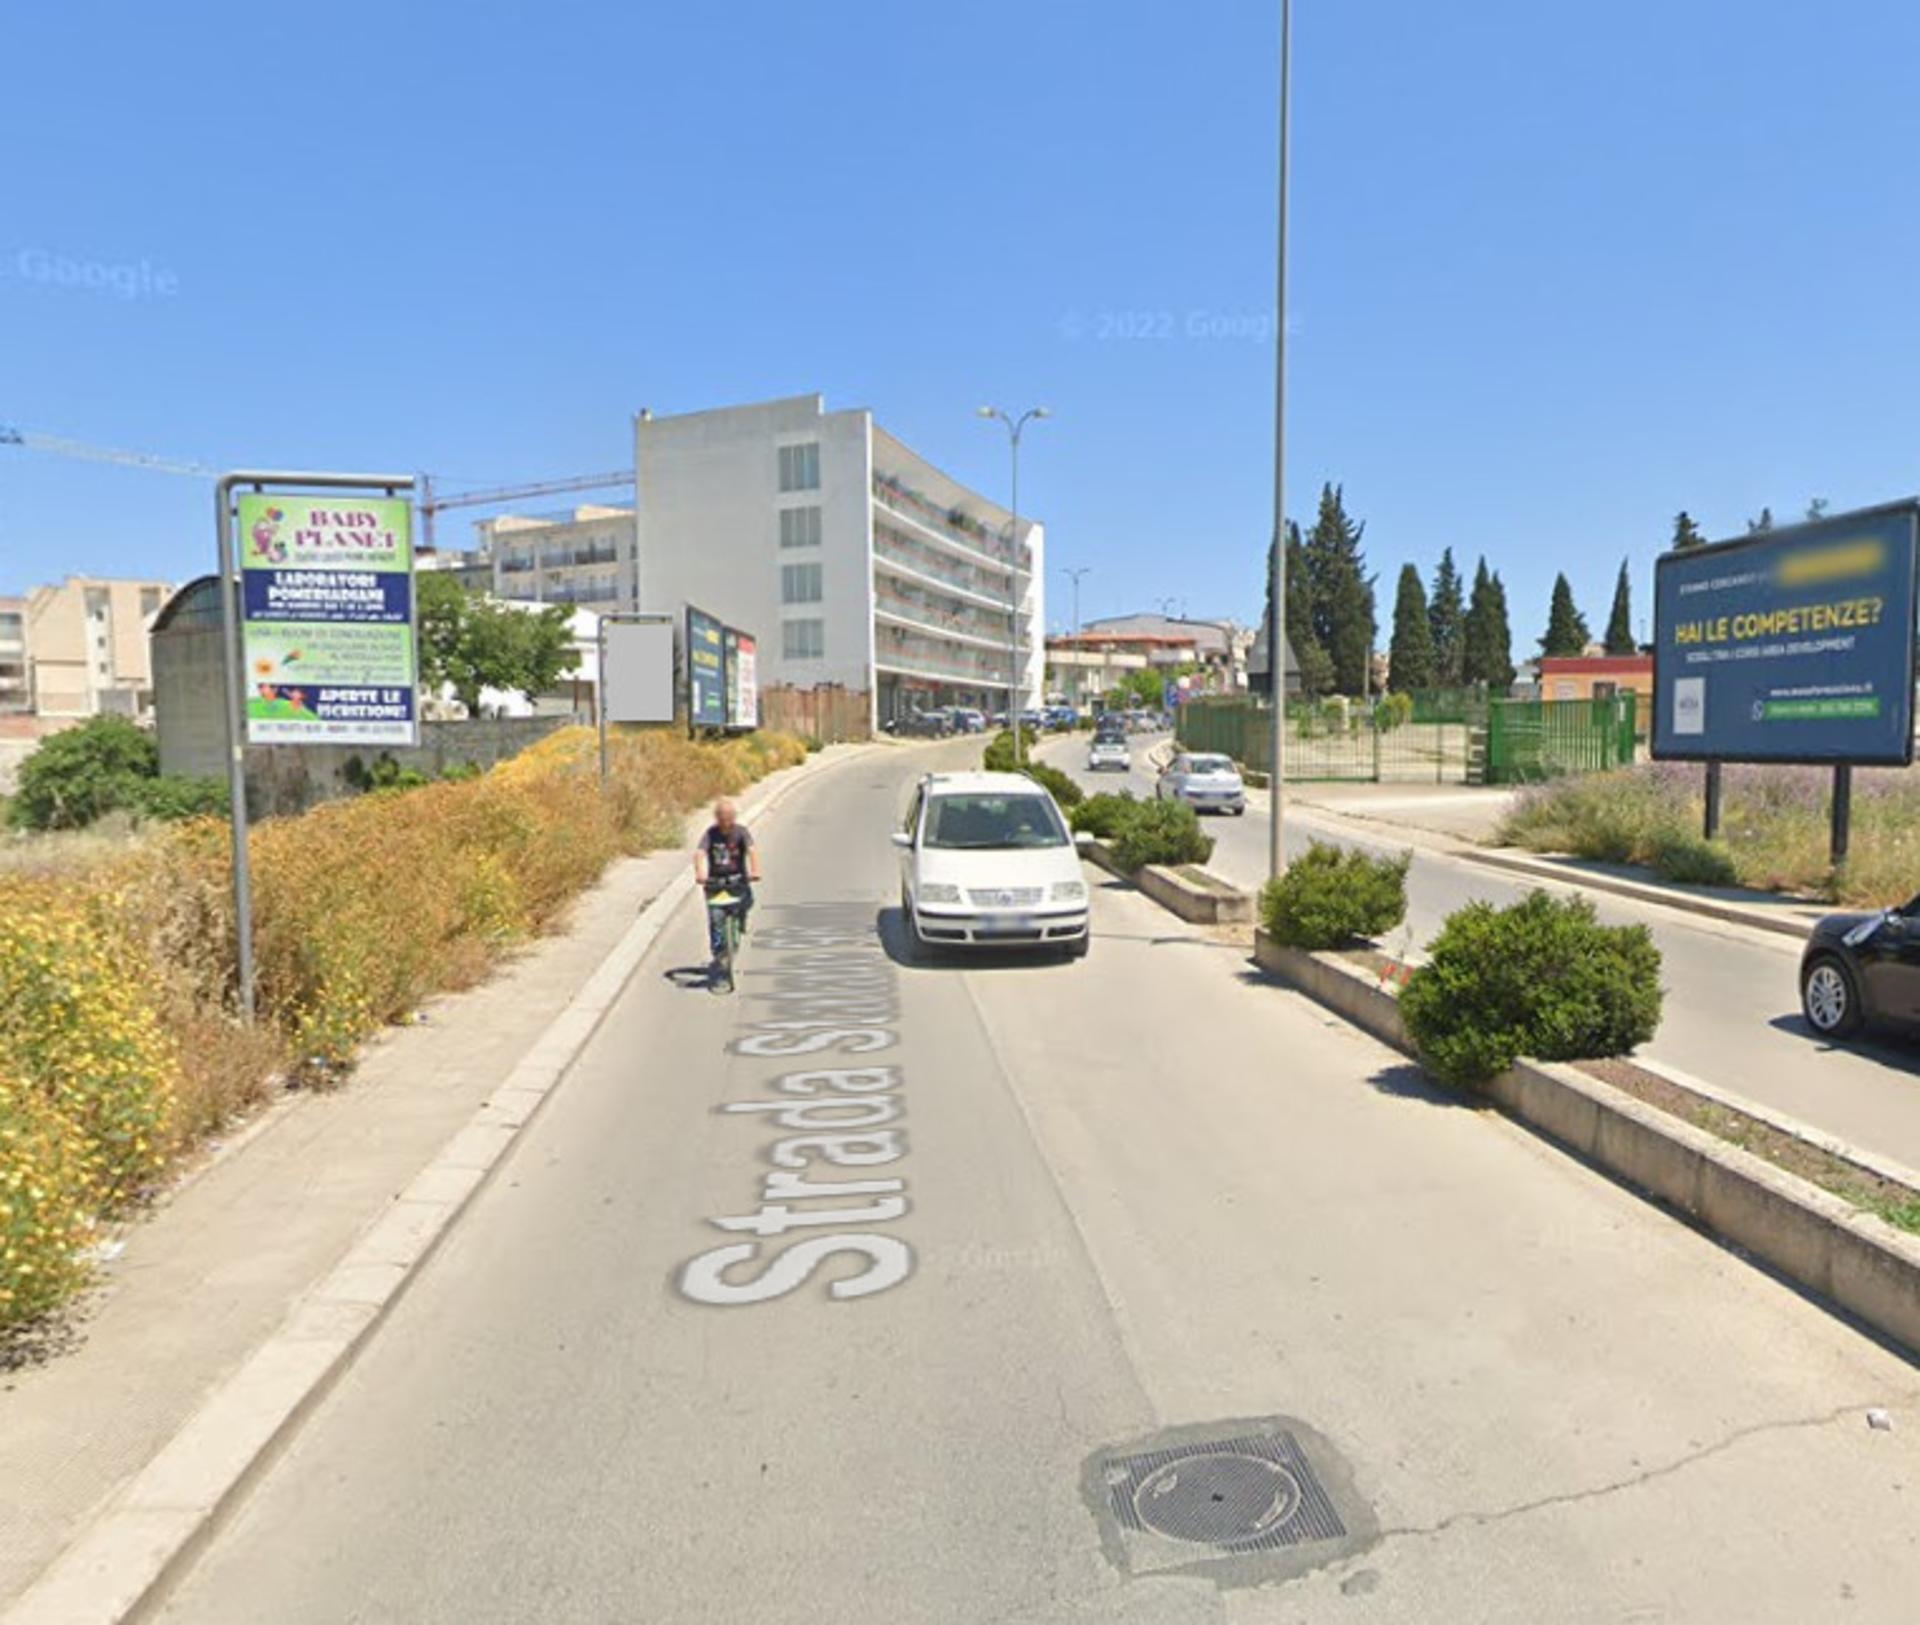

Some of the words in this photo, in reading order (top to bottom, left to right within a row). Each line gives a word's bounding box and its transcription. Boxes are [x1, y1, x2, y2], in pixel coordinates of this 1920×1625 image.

[310, 510, 377, 528] BABY
[294, 530, 394, 548] PLANET
[1674, 621, 1702, 645] HAI
[1706, 616, 1728, 641] LE
[1733, 597, 1882, 640] COMPETENZE?
[382, 690, 401, 704] LE
